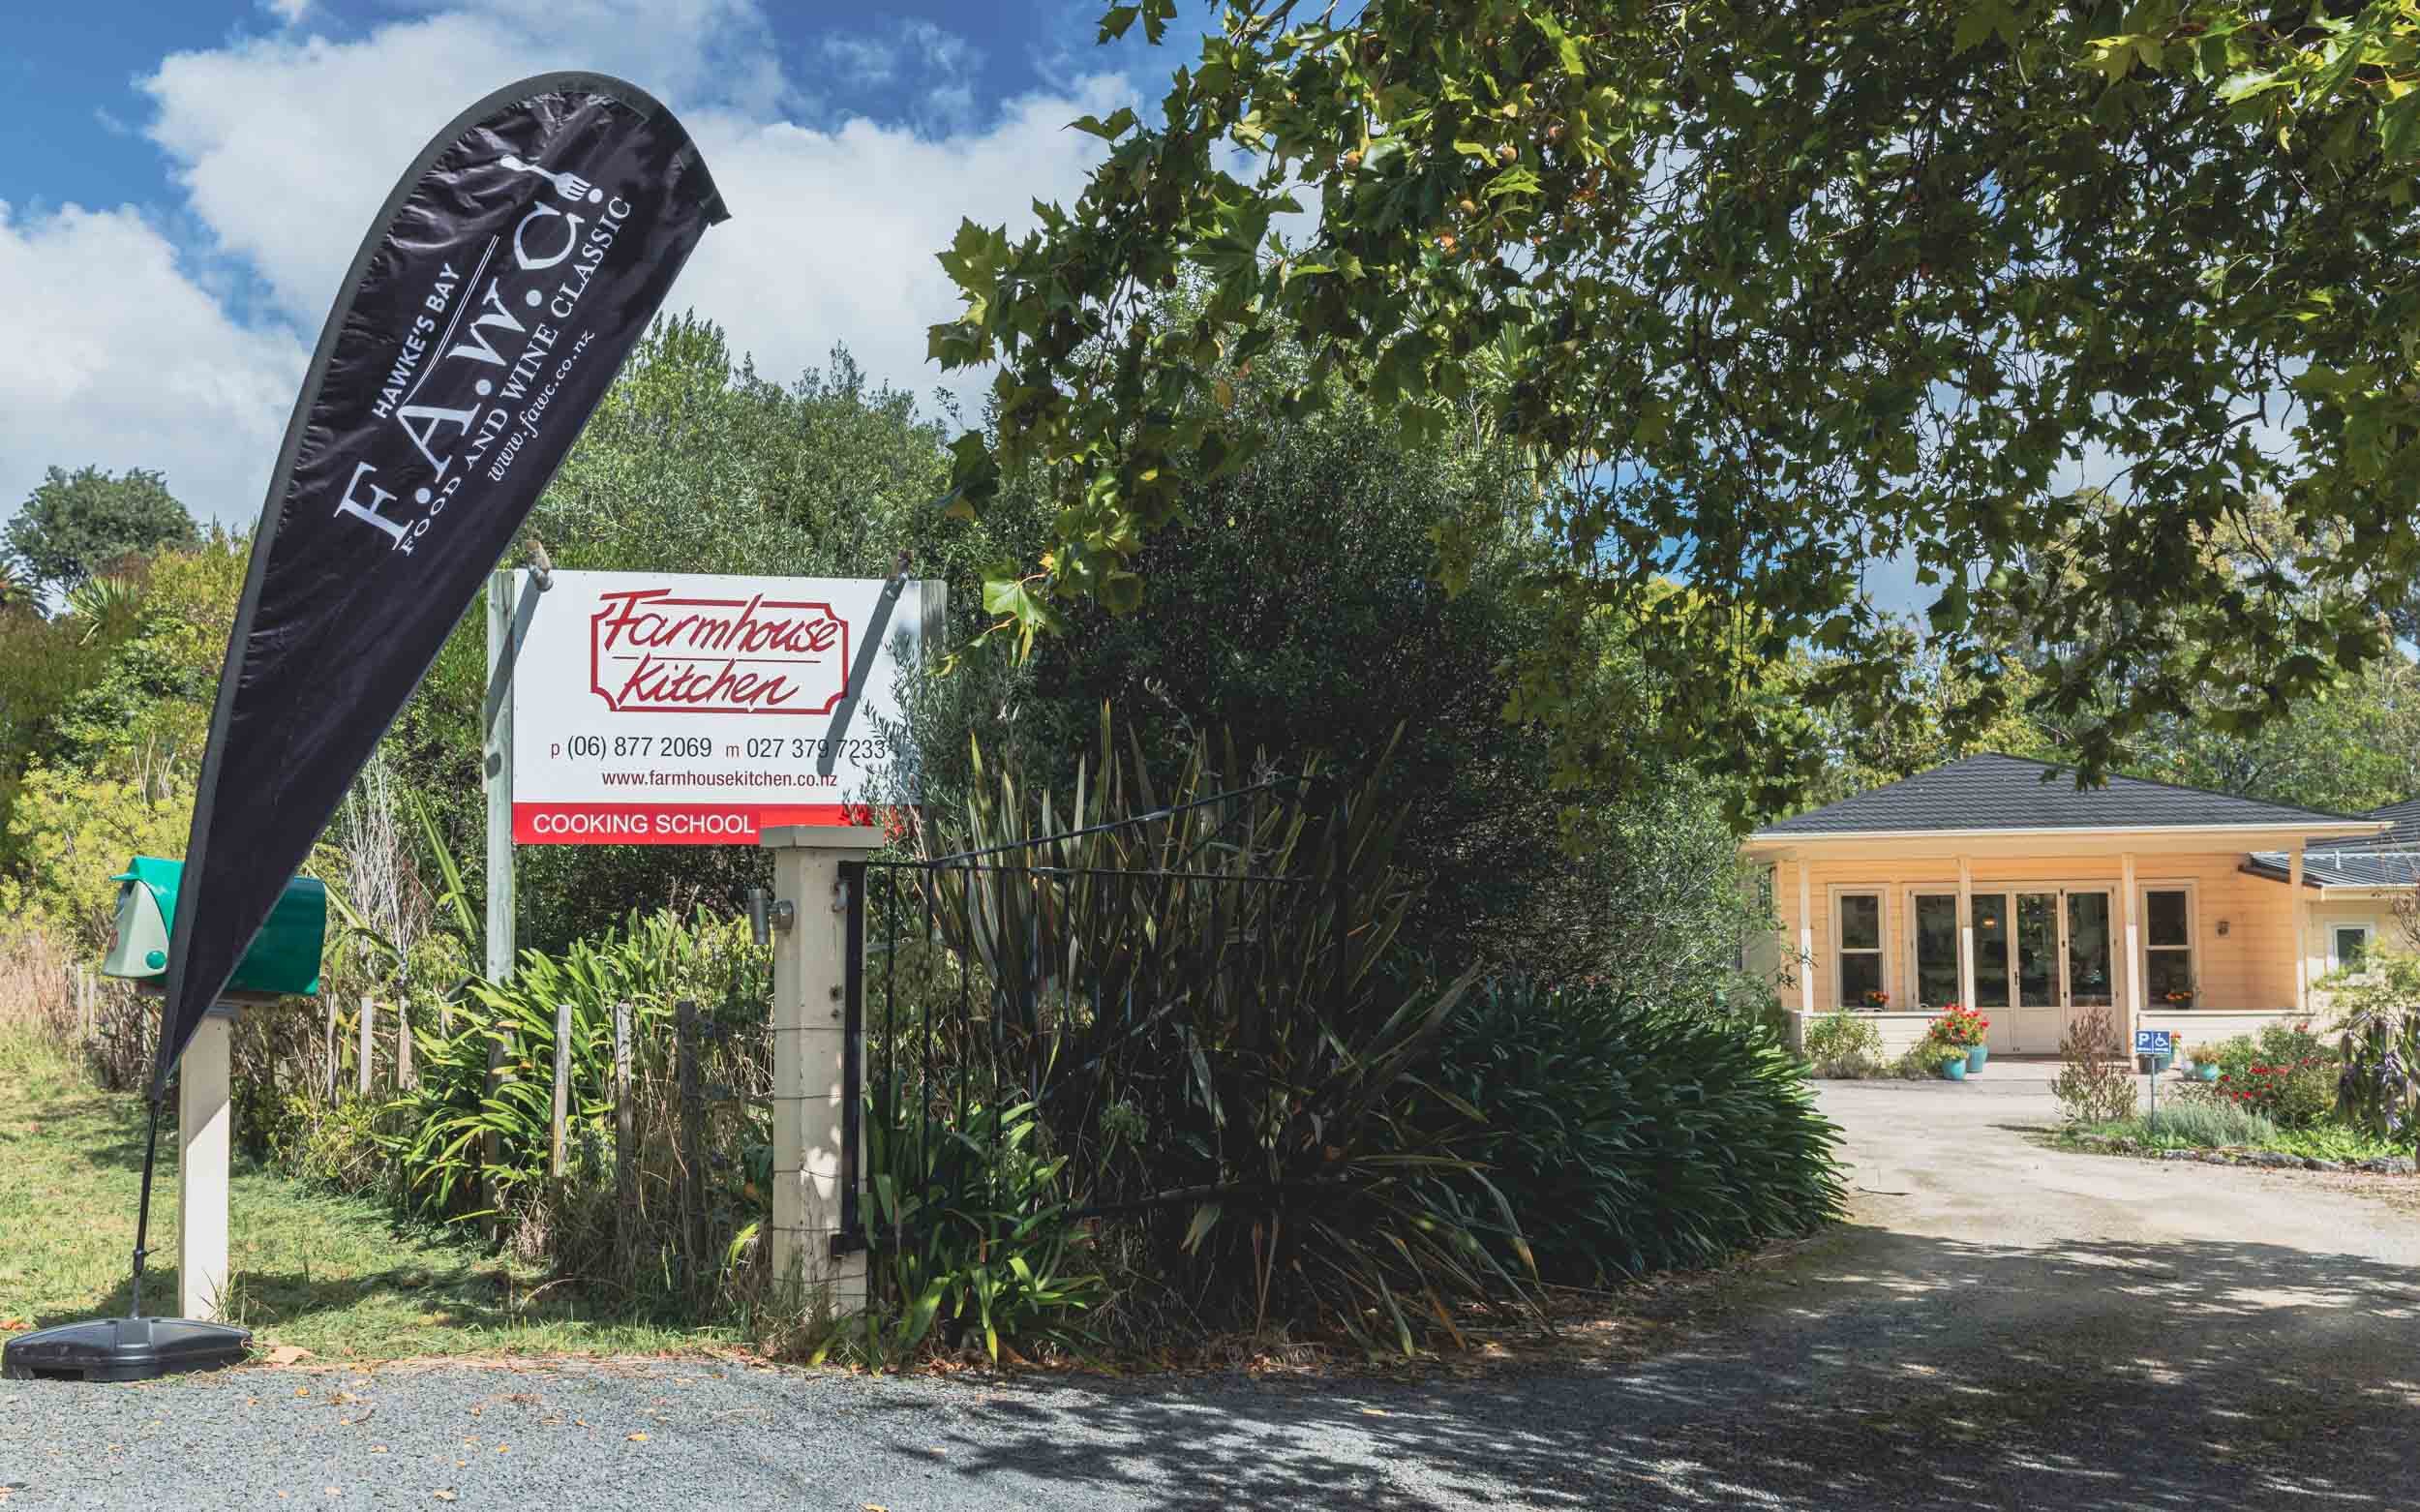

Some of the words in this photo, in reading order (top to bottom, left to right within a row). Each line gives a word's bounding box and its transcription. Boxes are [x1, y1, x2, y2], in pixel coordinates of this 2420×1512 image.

[372, 316, 436, 419] HAWKE'S
[425, 263, 462, 311] BAY
[401, 476, 462, 557] FOOD
[465, 408, 509, 471] AND
[499, 322, 559, 400] WINE
[550, 196, 632, 318] CLASSIC
[487, 329, 595, 482] www.fawc.co.nz
[599, 588, 839, 653] Farmhouse
[617, 651, 800, 706] Kitchen
[550, 742, 560, 759] p
[567, 735, 607, 761] (06)
[614, 737, 653, 757] 877
[660, 738, 712, 758] 2069
[725, 742, 741, 758] m
[746, 739, 784, 759] 027
[792, 739, 830, 759] 379
[835, 739, 886, 759] 7233
[601, 770, 837, 787] www.farmhousekitchen.co.nz
[533, 813, 649, 834] COOKING
[655, 814, 756, 835] SCHOOL
[2138, 1033, 2149, 1046] P
